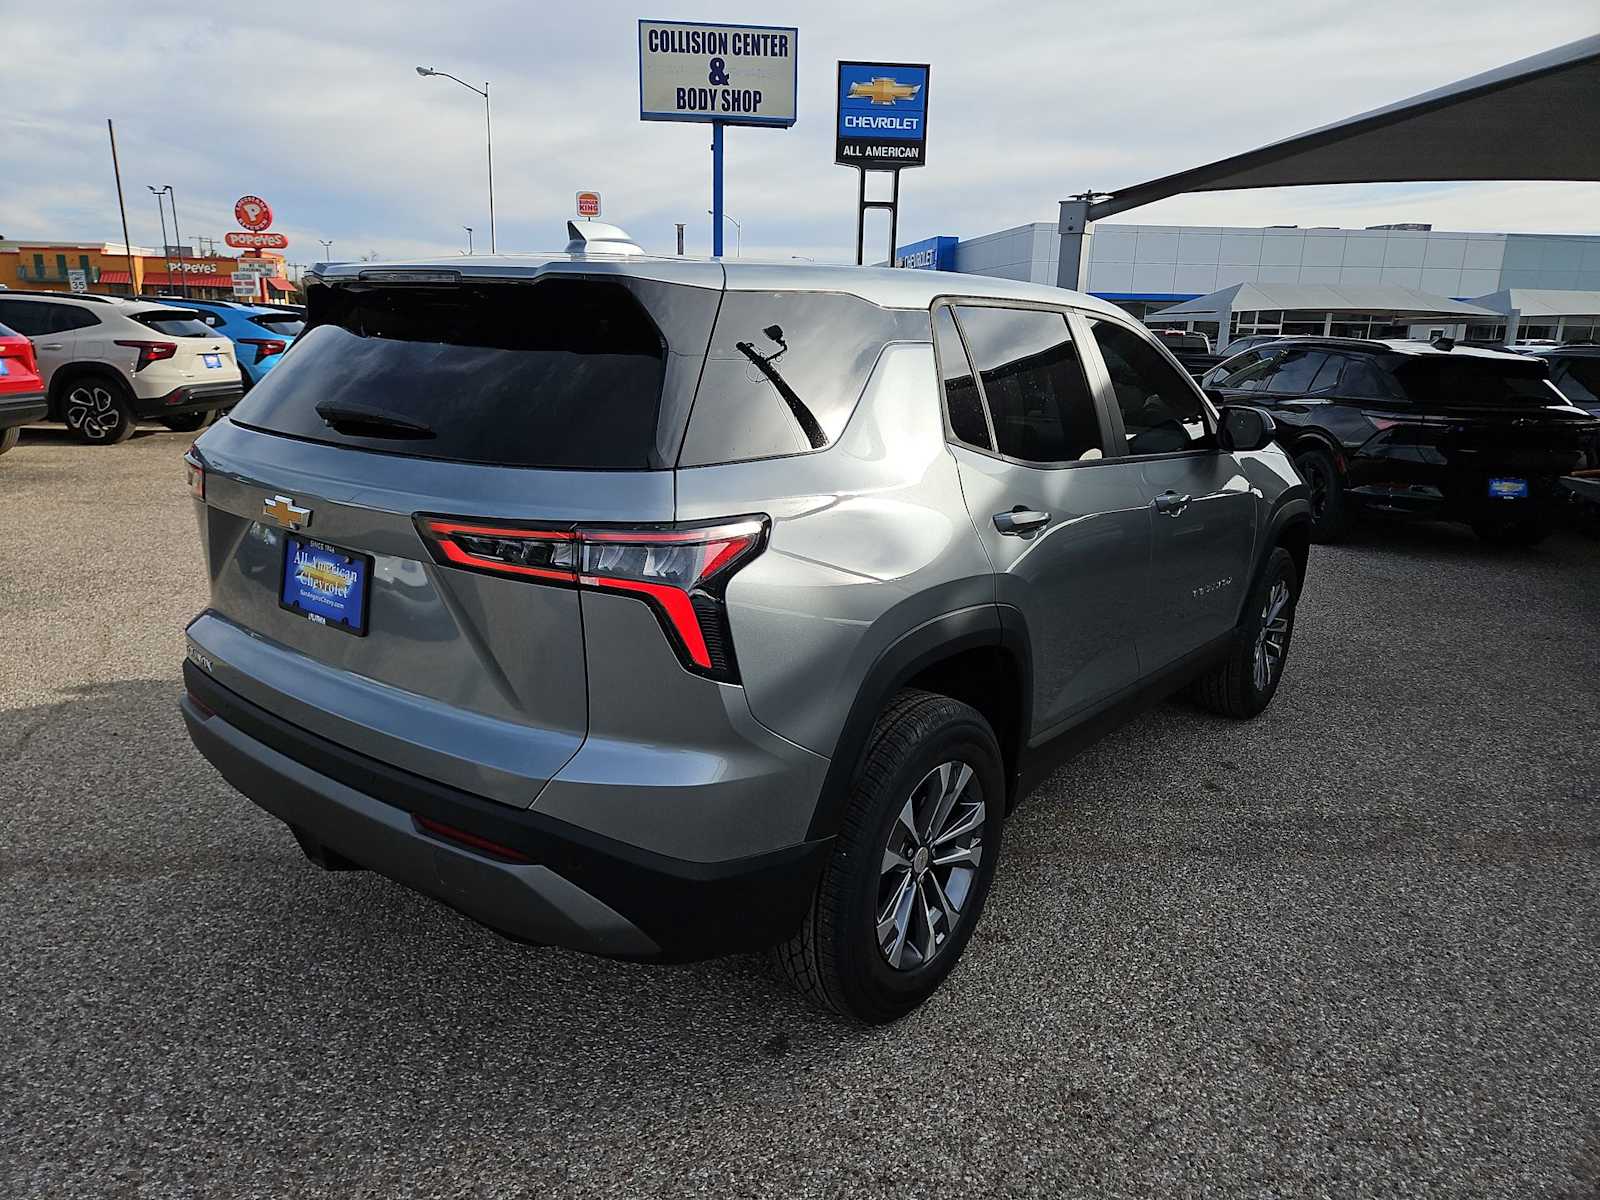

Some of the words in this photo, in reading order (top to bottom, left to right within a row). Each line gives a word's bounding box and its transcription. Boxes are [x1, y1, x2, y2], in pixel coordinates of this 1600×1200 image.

[648, 29, 728, 55] COLLISION
[732, 33, 789, 57] CENTER
[709, 57, 730, 86] &
[676, 88, 717, 111] BODY
[721, 89, 762, 113] SHOP
[845, 116, 919, 130] CHEVROLET
[843, 145, 862, 156] ALL
[865, 146, 919, 158] AMERICAN
[72, 281, 85, 290] 35
[293, 551, 309, 566] All
[310, 556, 358, 583] American
[300, 571, 349, 599] Chevrolet
